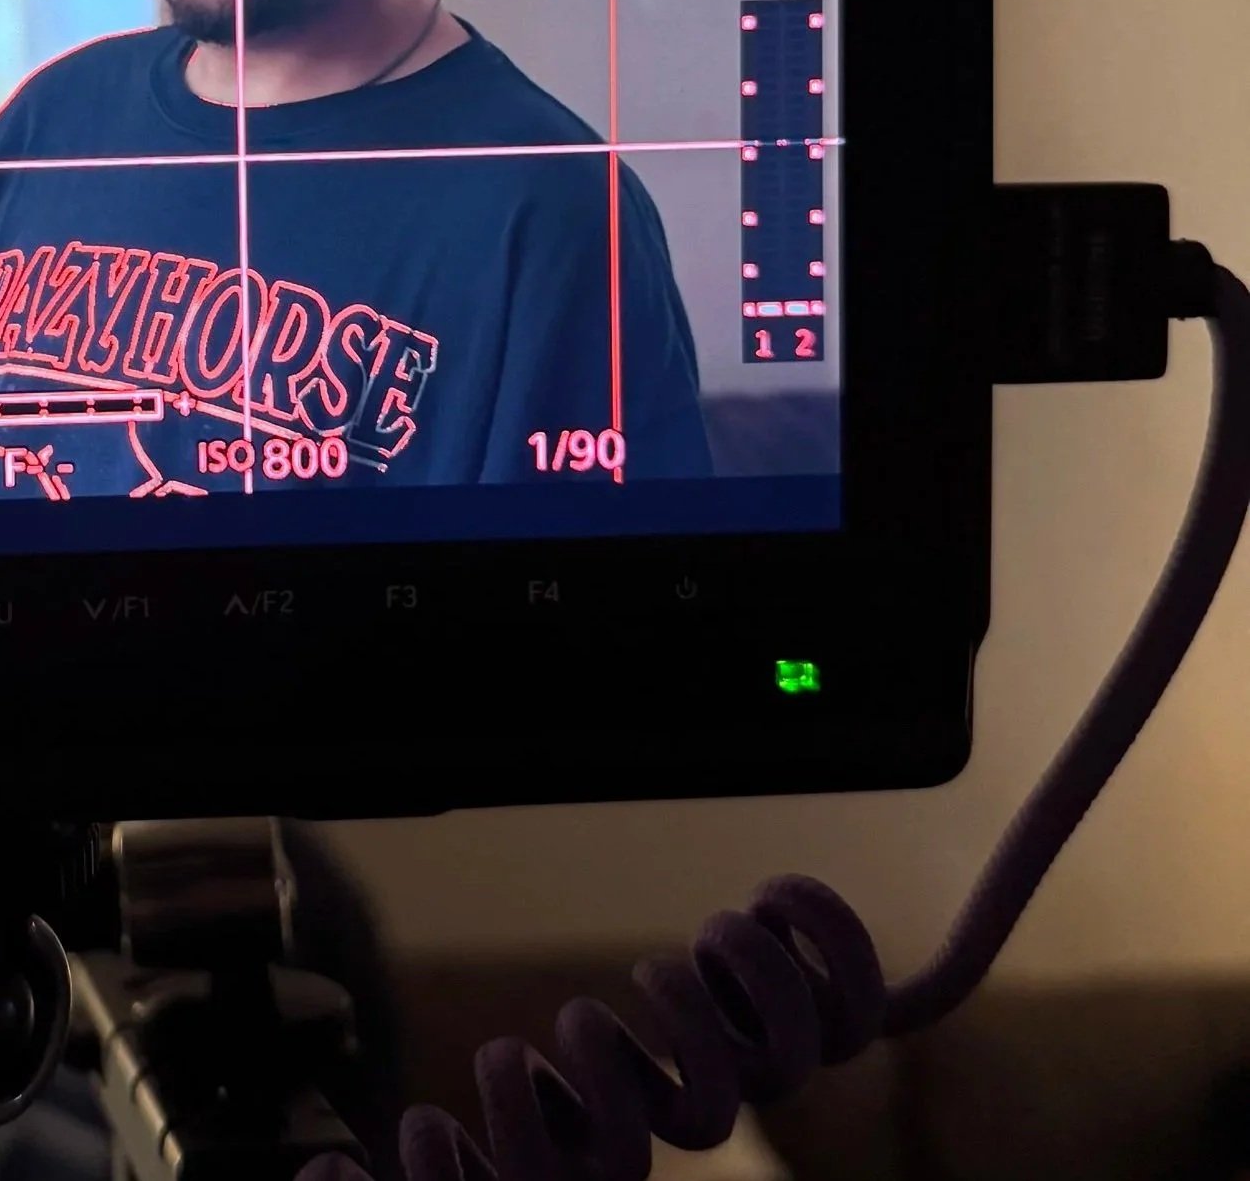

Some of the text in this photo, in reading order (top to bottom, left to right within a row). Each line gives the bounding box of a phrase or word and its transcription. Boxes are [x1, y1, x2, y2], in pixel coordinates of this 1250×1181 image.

[753, 326, 817, 359] 1 2
[198, 436, 348, 480] ISO 800
[527, 428, 626, 473] 1/90
[384, 584, 418, 611] F3
[527, 578, 561, 606] F4
